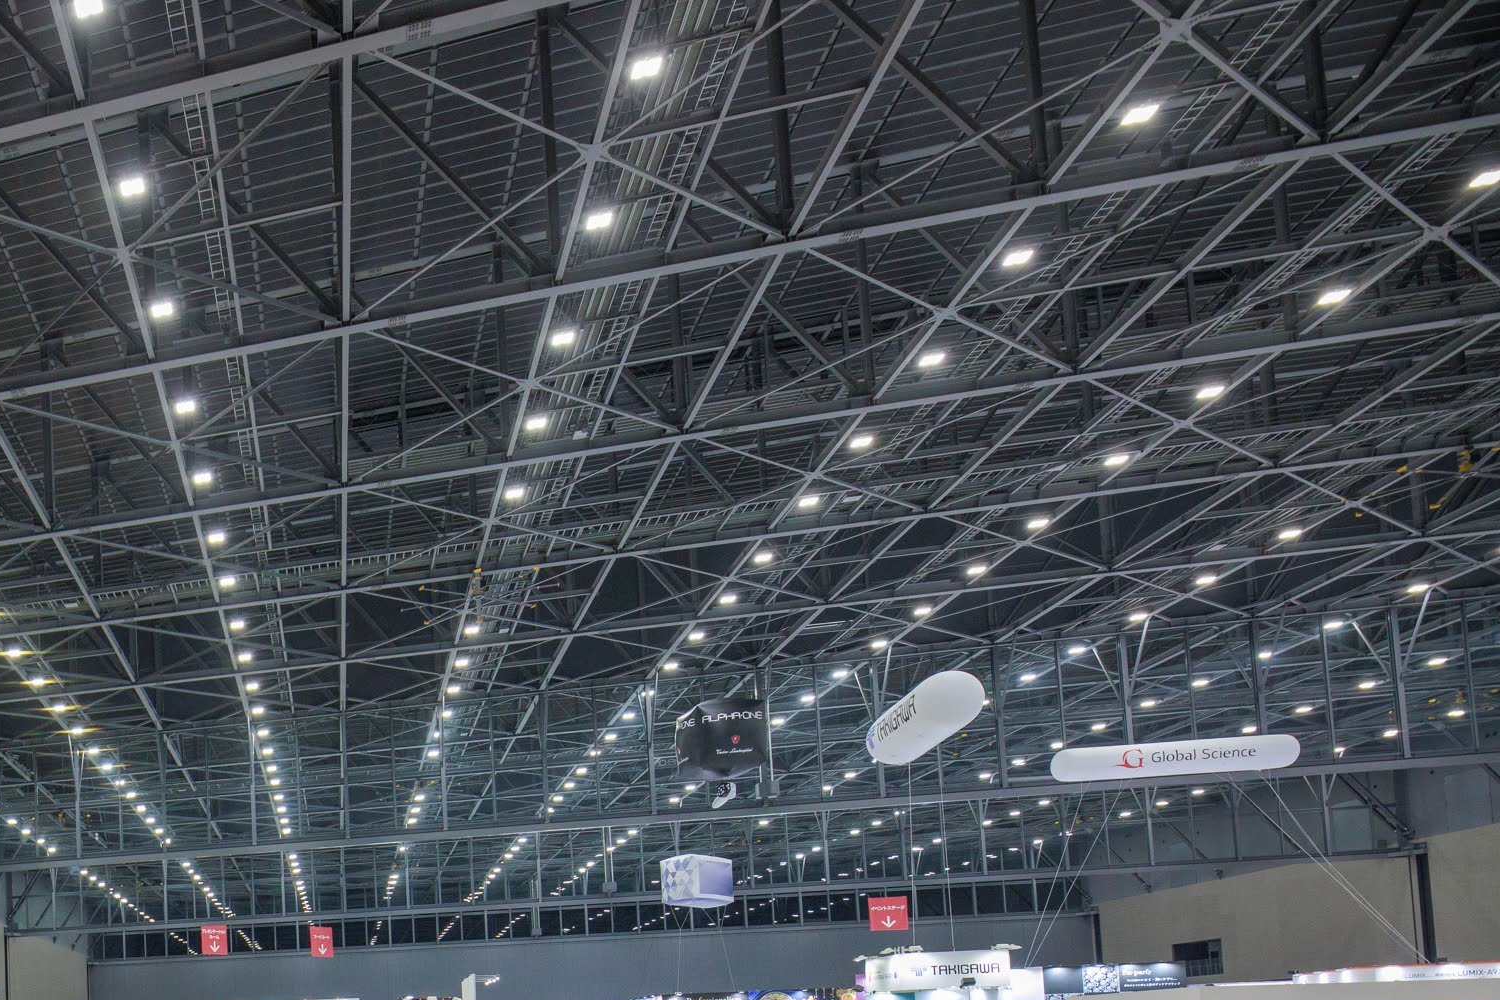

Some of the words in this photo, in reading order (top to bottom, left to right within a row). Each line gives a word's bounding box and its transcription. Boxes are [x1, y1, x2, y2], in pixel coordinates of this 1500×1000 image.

[876, 694, 917, 742] TAKIGAWA
[1151, 750, 1197, 763] Global
[1201, 748, 1257, 760] Science
[930, 962, 1001, 976] TAKIGAWA
